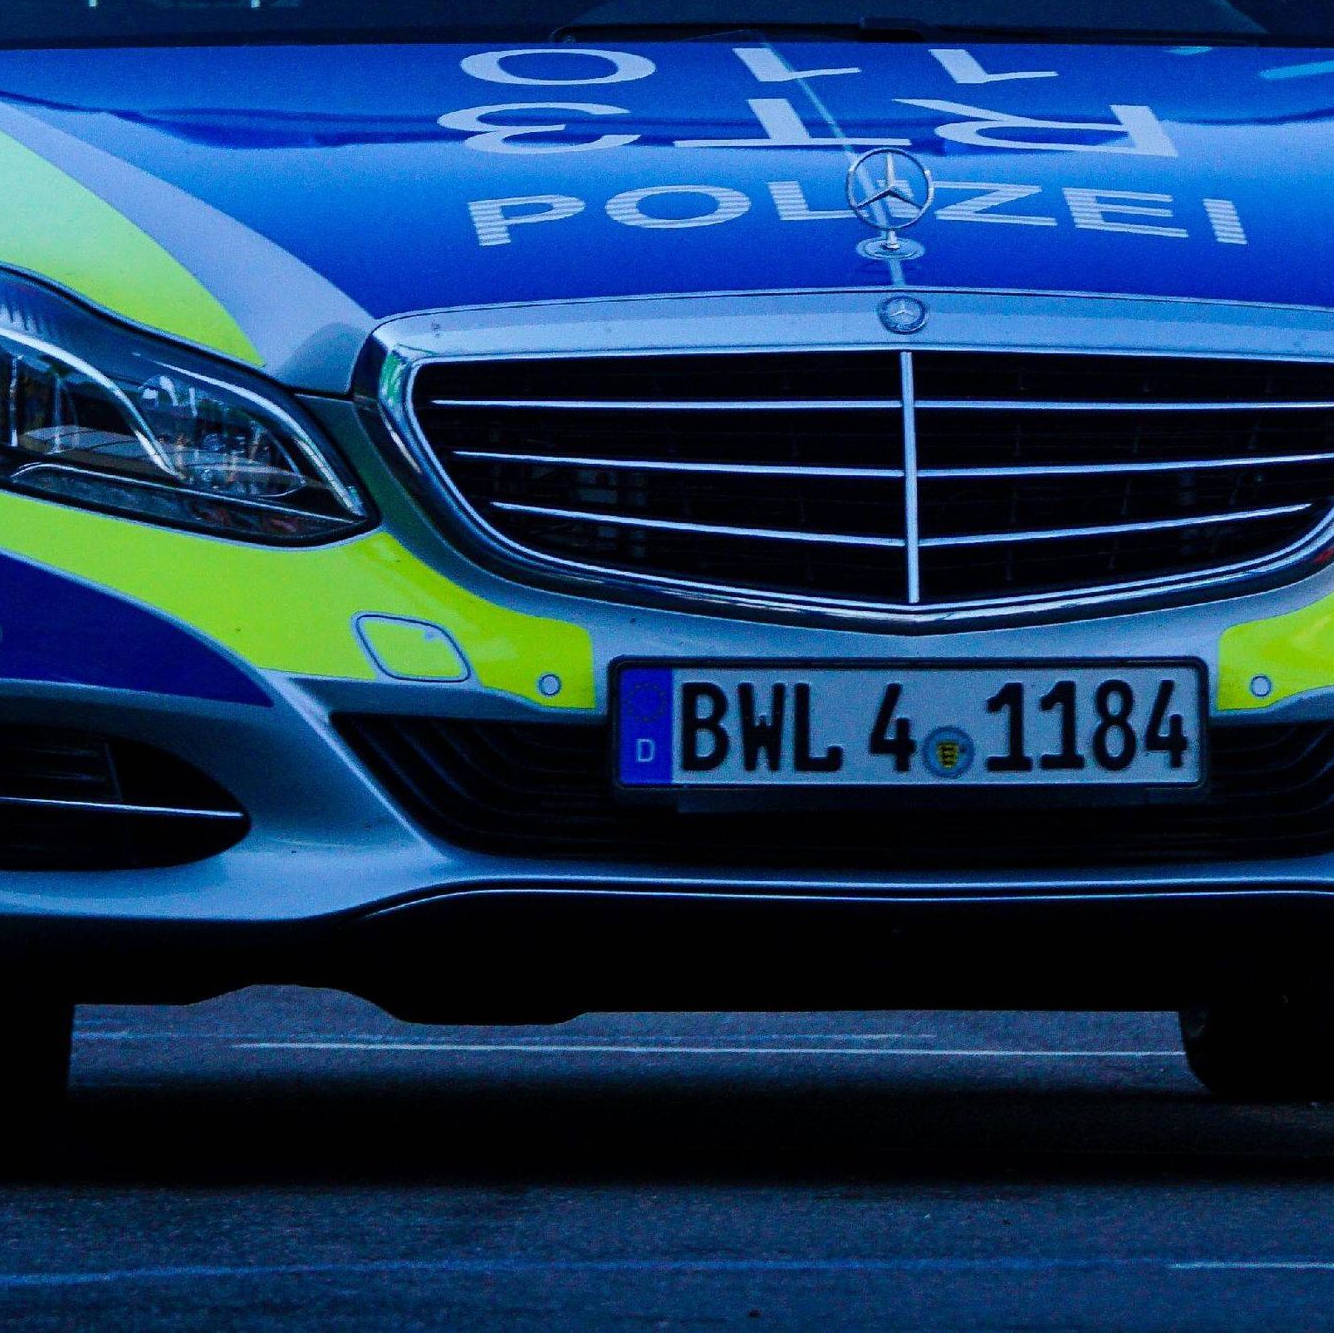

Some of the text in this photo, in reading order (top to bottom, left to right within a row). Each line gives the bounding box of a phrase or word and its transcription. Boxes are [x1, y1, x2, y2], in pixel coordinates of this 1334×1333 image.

[467, 180, 1248, 246] POLIZEI
[635, 737, 656, 763] D
[680, 678, 1189, 773] BWL 4 1184
